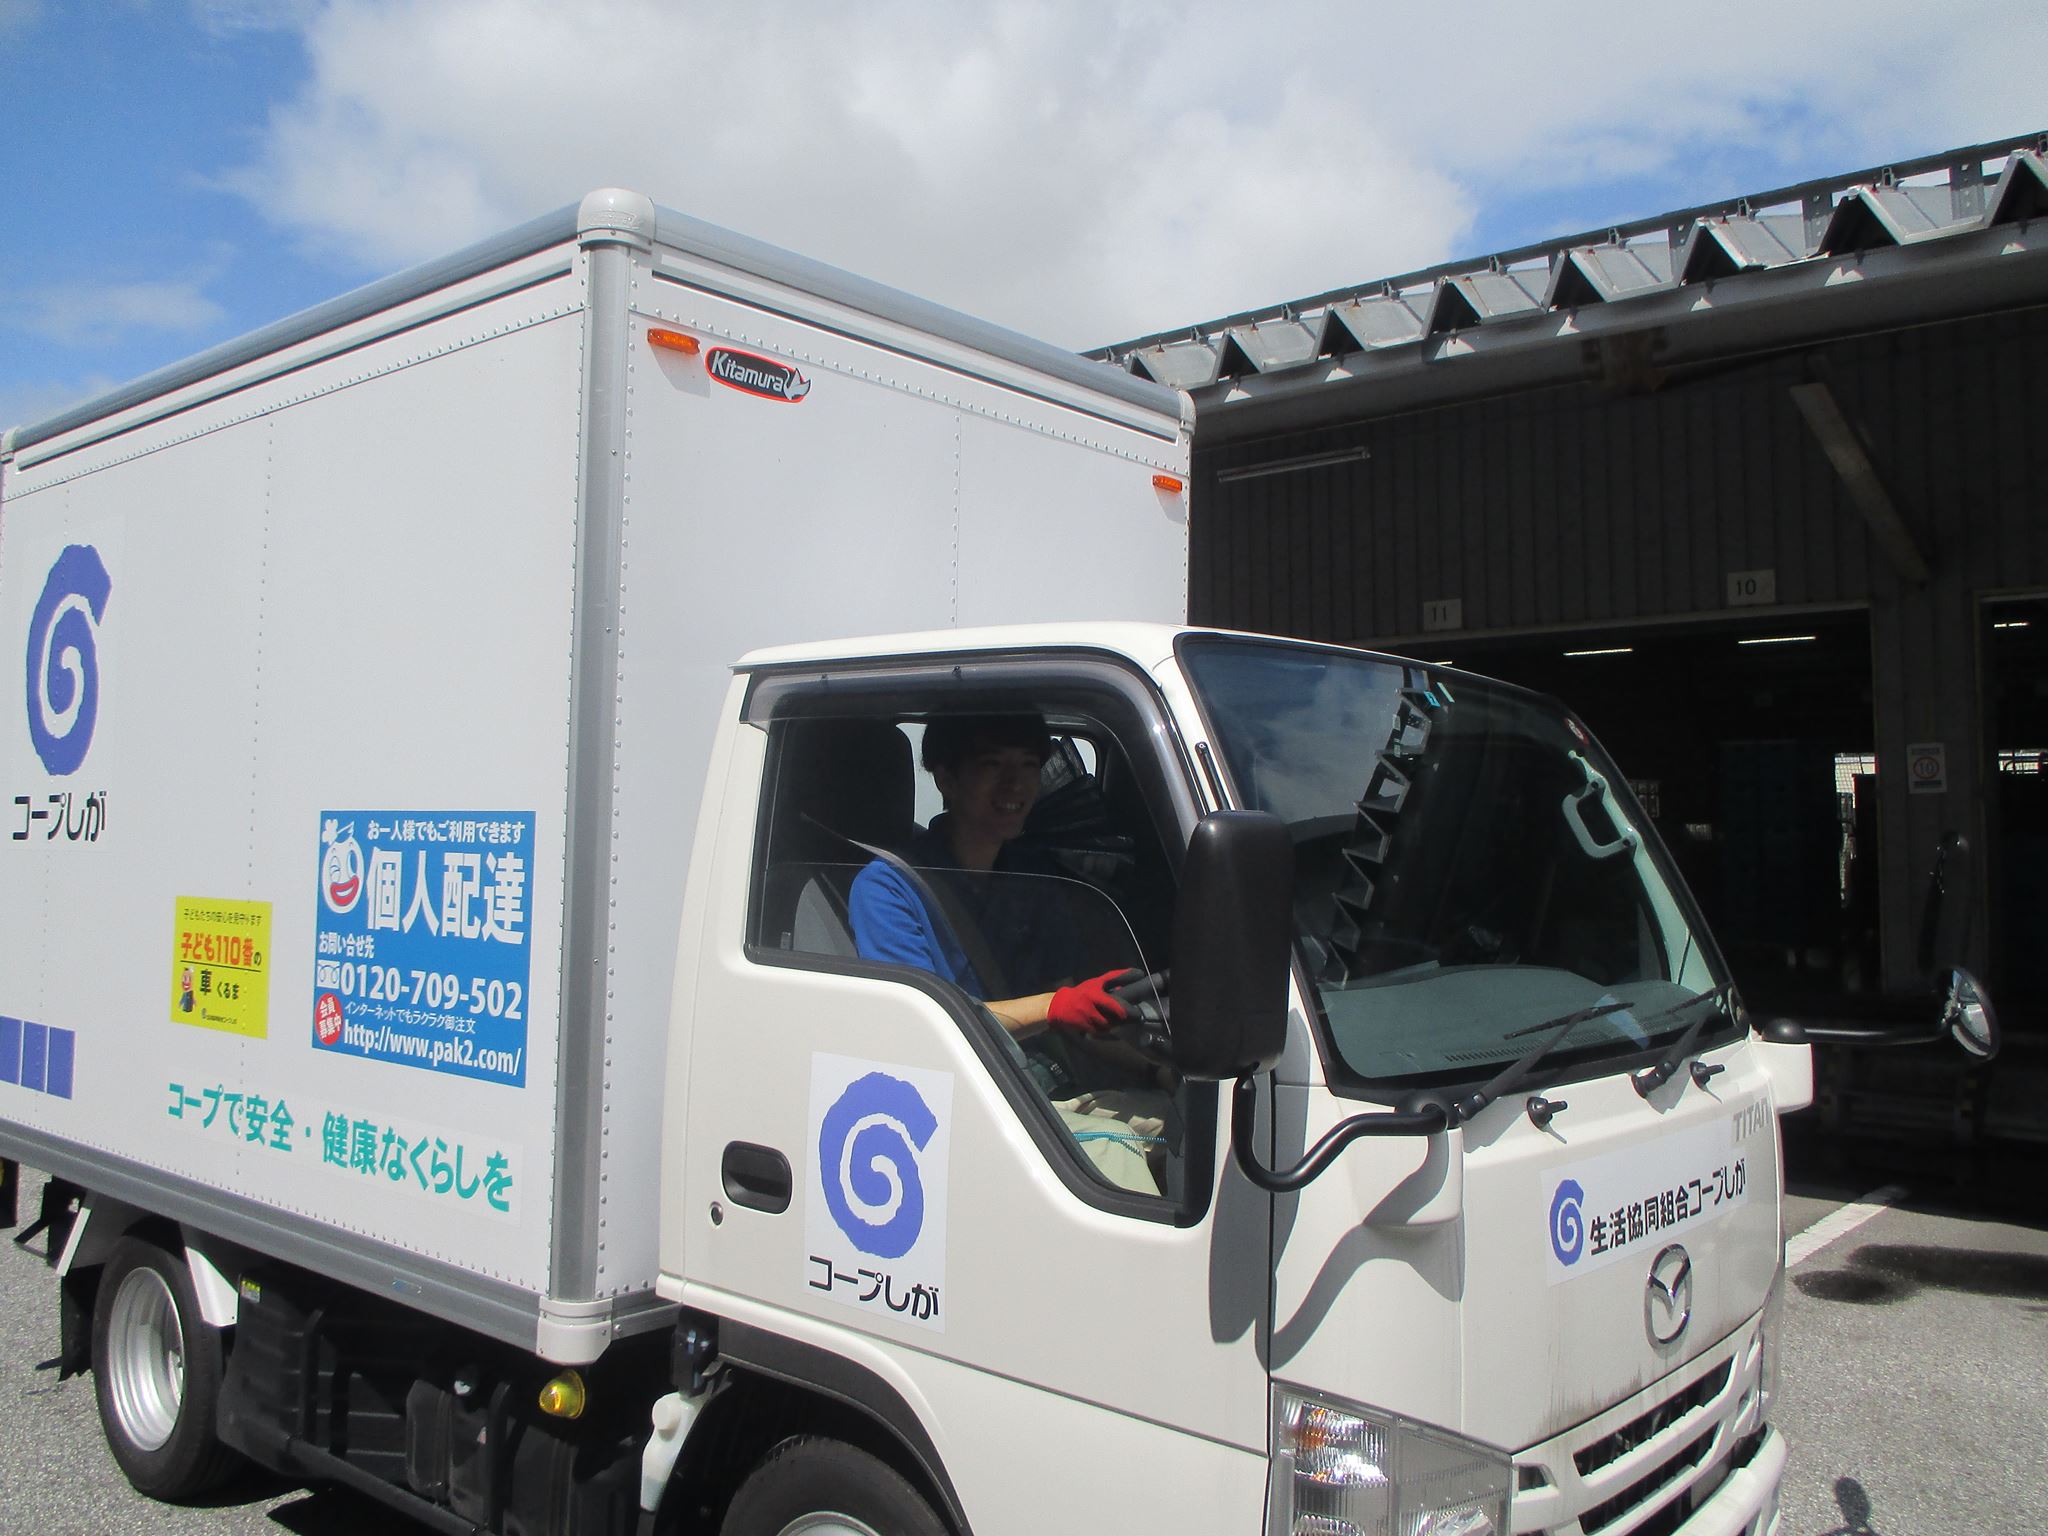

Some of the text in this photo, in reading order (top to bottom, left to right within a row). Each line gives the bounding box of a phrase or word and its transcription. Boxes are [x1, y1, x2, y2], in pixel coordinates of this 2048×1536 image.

[711, 351, 784, 392] Kitamura
[1736, 578, 1756, 596] 10
[1432, 605, 1447, 622] 11
[12, 790, 107, 842] コープしが
[368, 819, 526, 844] お一人様でもご利用できます
[366, 847, 526, 945] 個人配達
[181, 932, 262, 967] 子ども110番の
[319, 931, 375, 959] お問い合せ先
[200, 969, 240, 1000] 車 くるま
[340, 962, 522, 1020] 0120-709-502
[344, 1019, 522, 1076] http://www.pak2.com/
[1733, 1097, 1769, 1143] TITAN
[168, 1083, 514, 1212] コープで安全・健康なくらしを
[1589, 1157, 1747, 1256] 生活協同組合コープしが
[809, 1255, 940, 1320] コープしが
